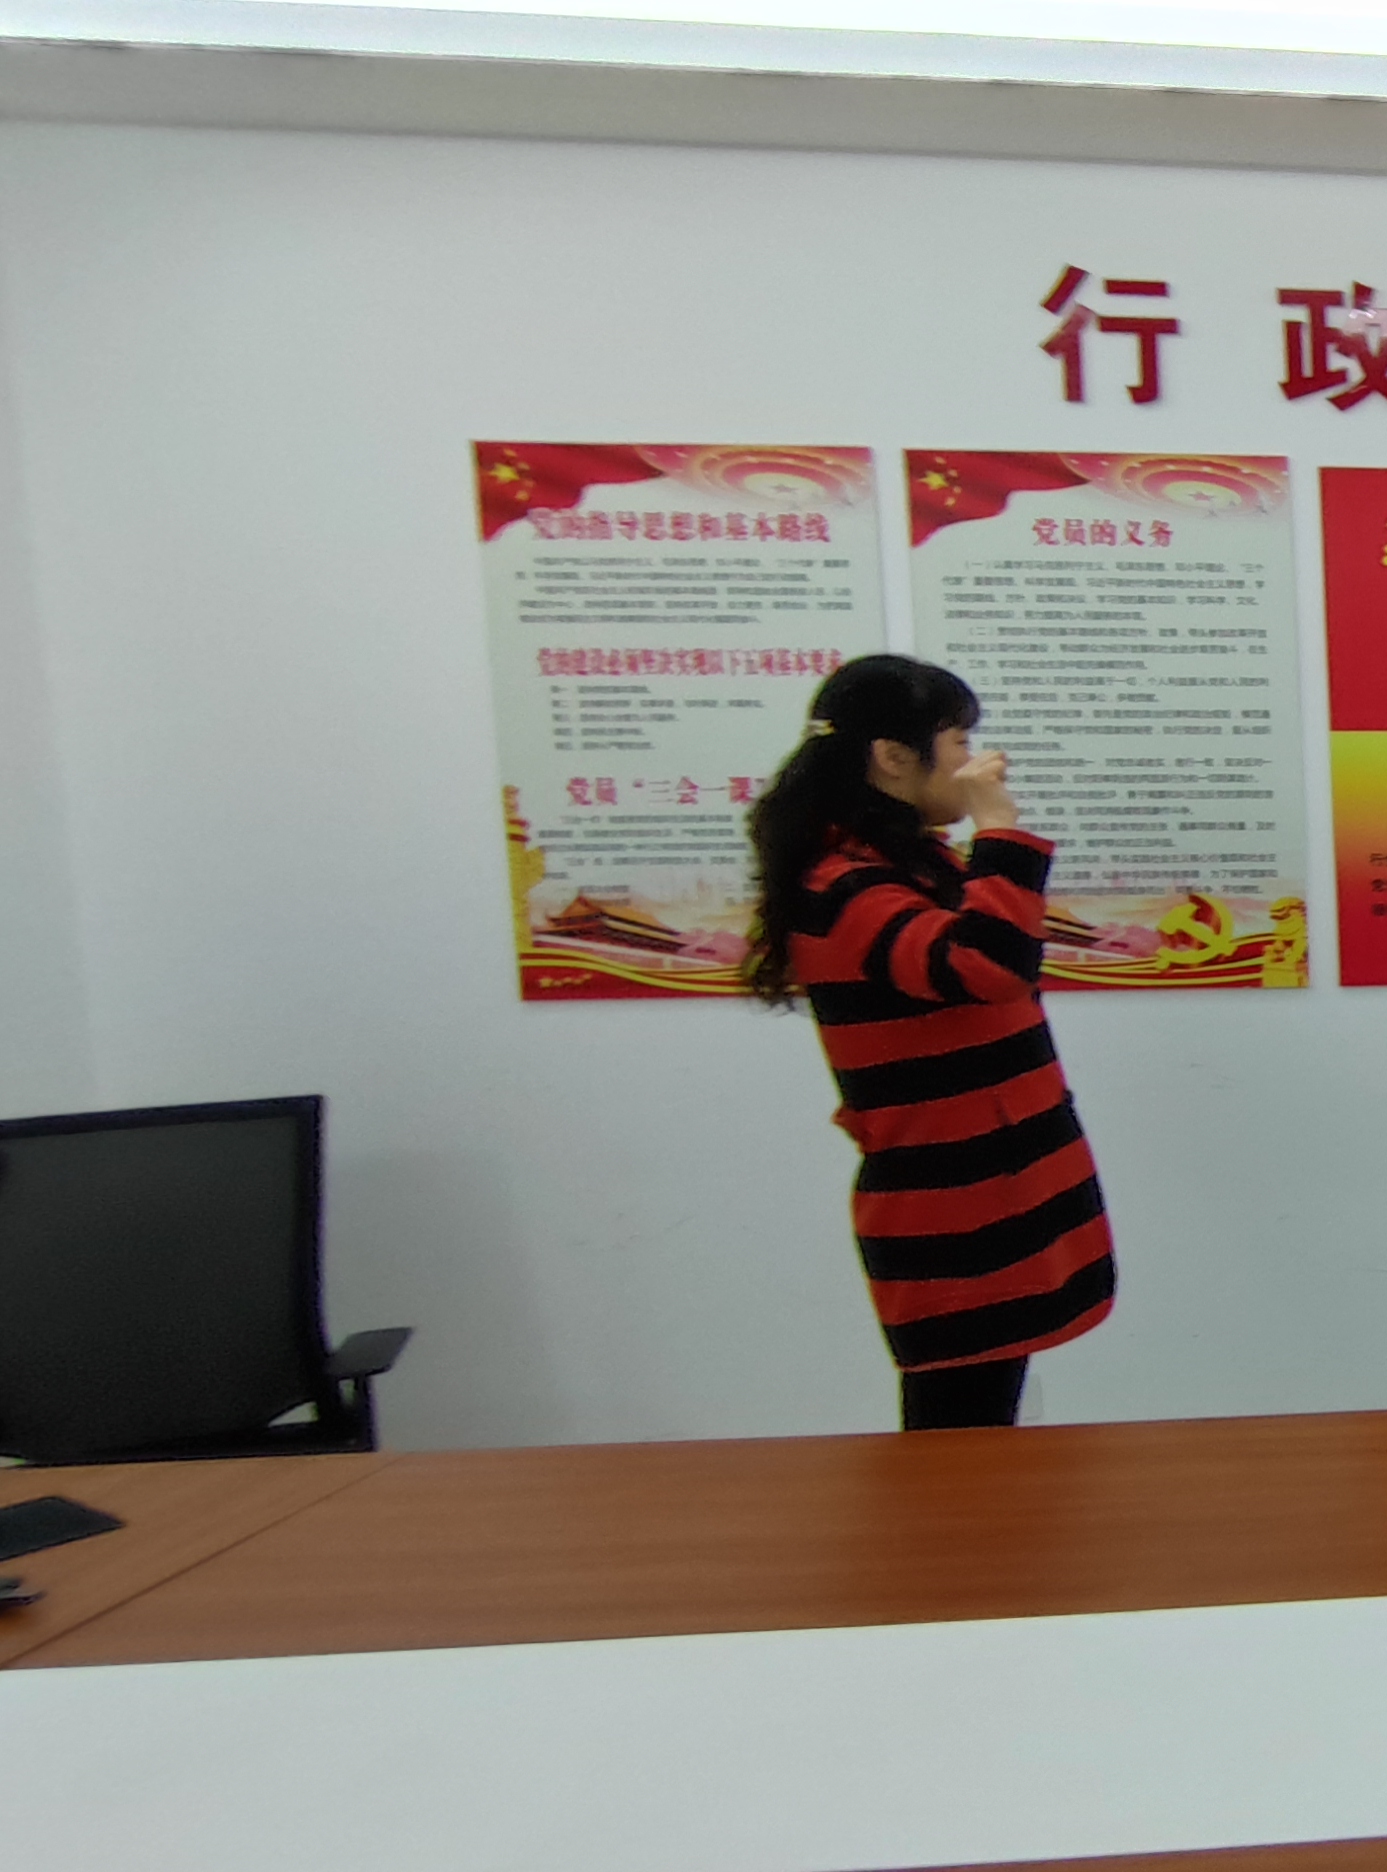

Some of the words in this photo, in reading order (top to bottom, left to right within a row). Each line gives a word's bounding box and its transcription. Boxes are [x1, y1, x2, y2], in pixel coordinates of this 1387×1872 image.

[528, 507, 831, 543] 党的指导思想和基本路线
[1031, 517, 1173, 548] 党员的义务
